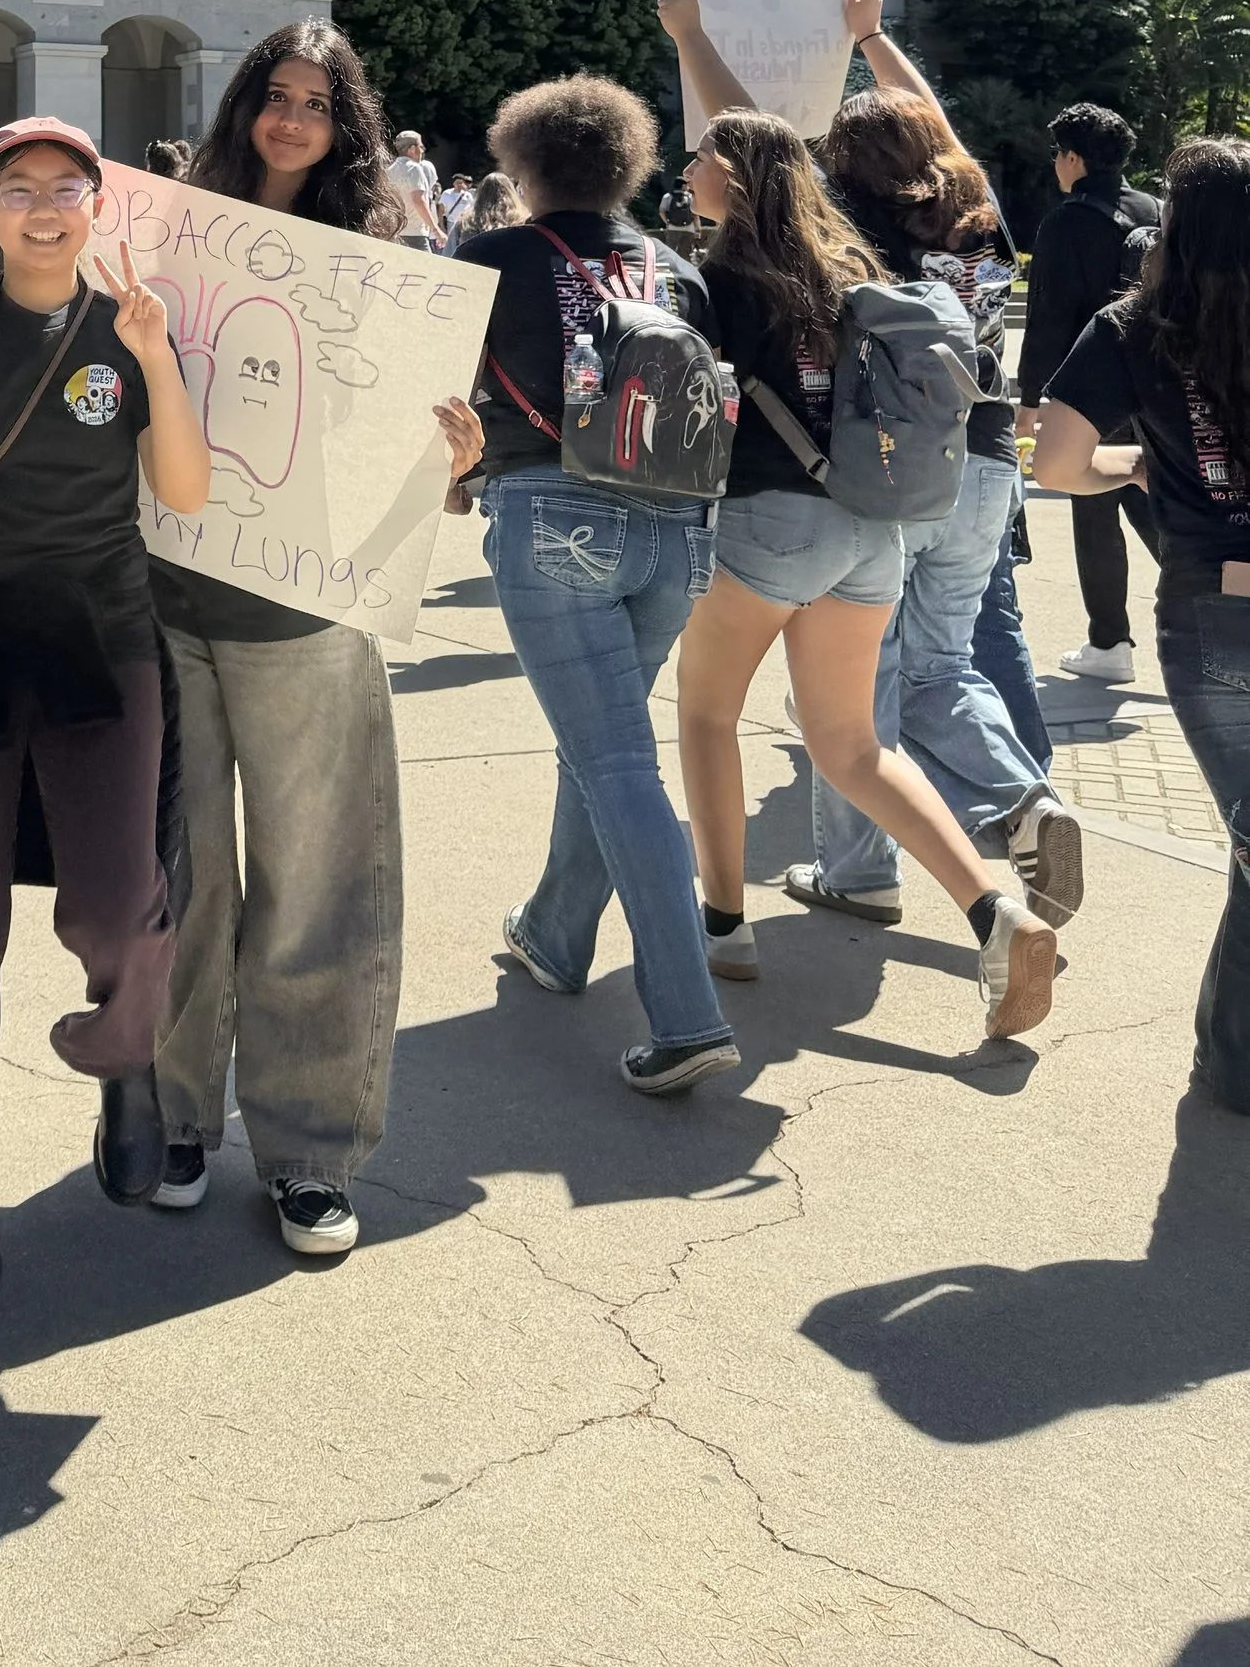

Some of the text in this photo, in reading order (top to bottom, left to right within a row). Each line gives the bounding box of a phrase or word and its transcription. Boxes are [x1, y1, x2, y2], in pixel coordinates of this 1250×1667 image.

[91, 183, 467, 322] OBACCO FREE
[90, 367, 115, 376] YOUTH
[88, 375, 115, 385] QUEST
